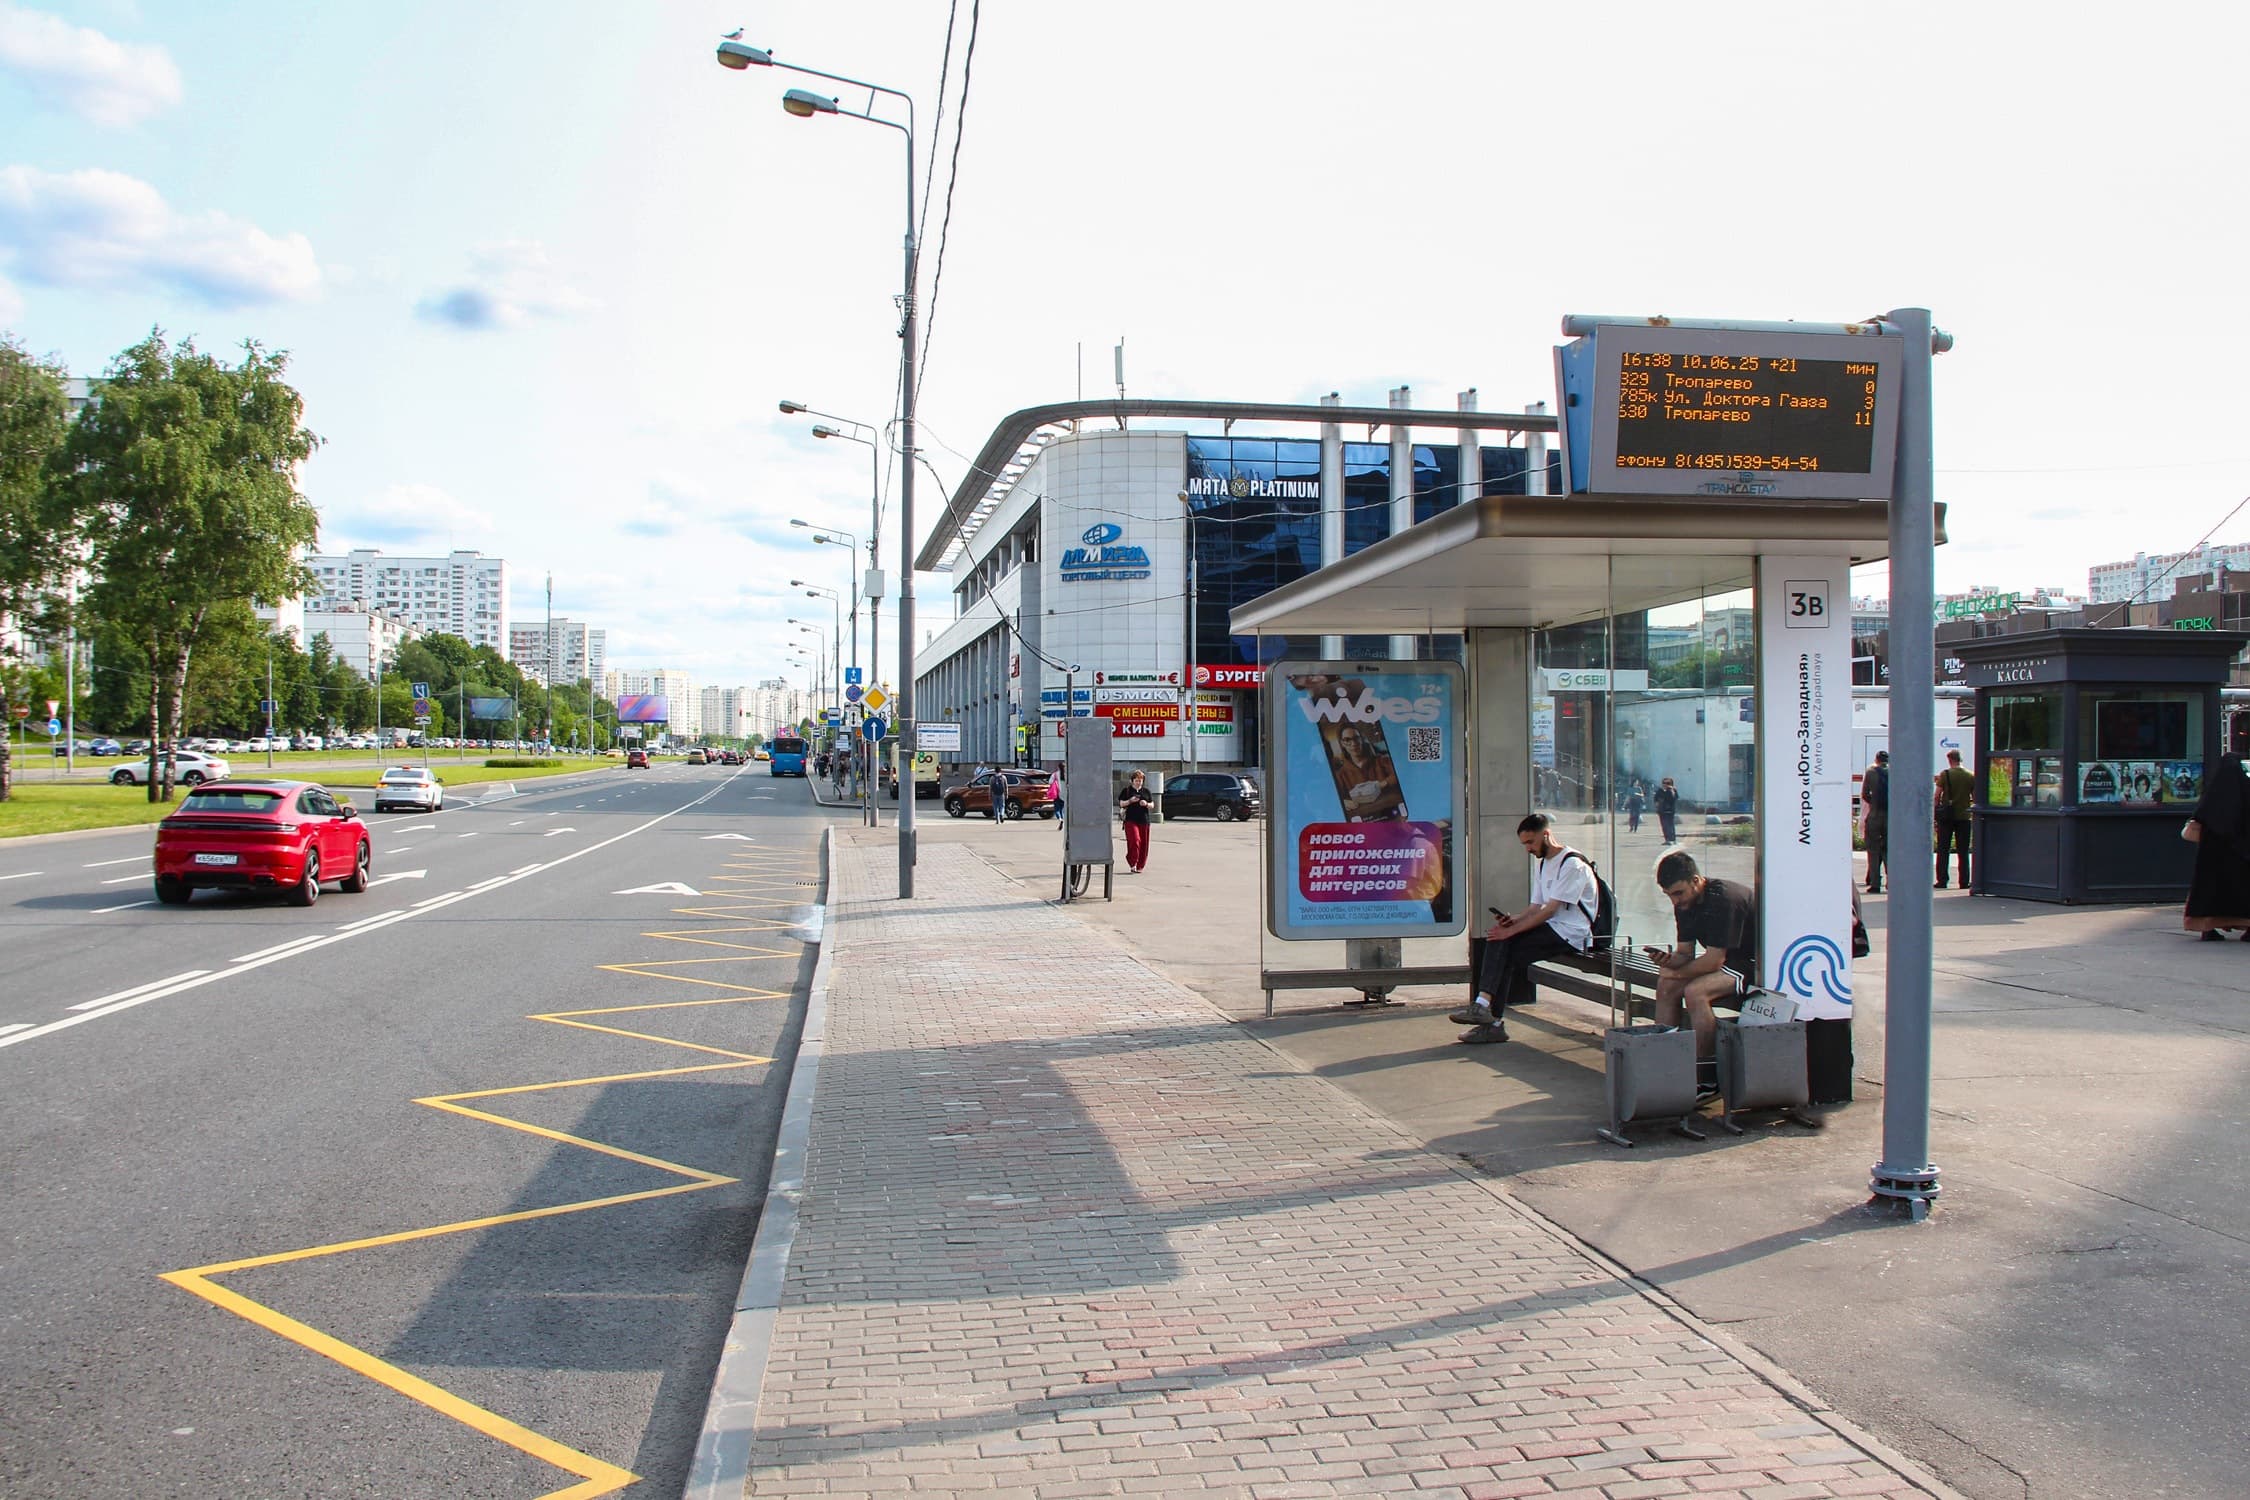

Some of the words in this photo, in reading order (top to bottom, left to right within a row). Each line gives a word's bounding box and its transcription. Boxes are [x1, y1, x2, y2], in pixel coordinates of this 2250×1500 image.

[1623, 352, 1671, 367] 16:38
[1682, 354, 1758, 370] 10.06.25
[1769, 358, 1797, 372] +21
[1621, 372, 1649, 386] 329
[1665, 373, 1752, 390] Тропарево
[1865, 381, 1875, 394] 0
[1620, 388, 1658, 402] 785к
[1664, 389, 1690, 404] Ул.
[1703, 391, 1771, 407] Доктора
[1779, 394, 1828, 408] Гааза
[1864, 396, 1874, 409] 3
[1664, 406, 1751, 422] Тропарево
[1855, 411, 1871, 425] 11
[1675, 454, 1818, 470] 8(495)539-54-54
[1189, 478, 1229, 495] МЯТА
[1250, 480, 1319, 498] PLATINUM
[1997, 669, 2033, 682] КАССА
[1812, 653, 1824, 740] Yugo-Zapadnaya
[1113, 707, 1178, 717] СМЕШНЫЕ
[1797, 653, 1812, 786] «Юго-Западная»
[1122, 724, 1161, 734] КИНГ
[1814, 742, 1822, 775] Metro
[1798, 790, 1813, 845] Метро
[1310, 833, 1365, 845] новое
[1310, 848, 1425, 864] приложение
[1309, 865, 1344, 878] для
[1349, 864, 1401, 875] твоих
[1310, 880, 1408, 895] интересов
[1749, 1000, 1777, 1019] Luck
